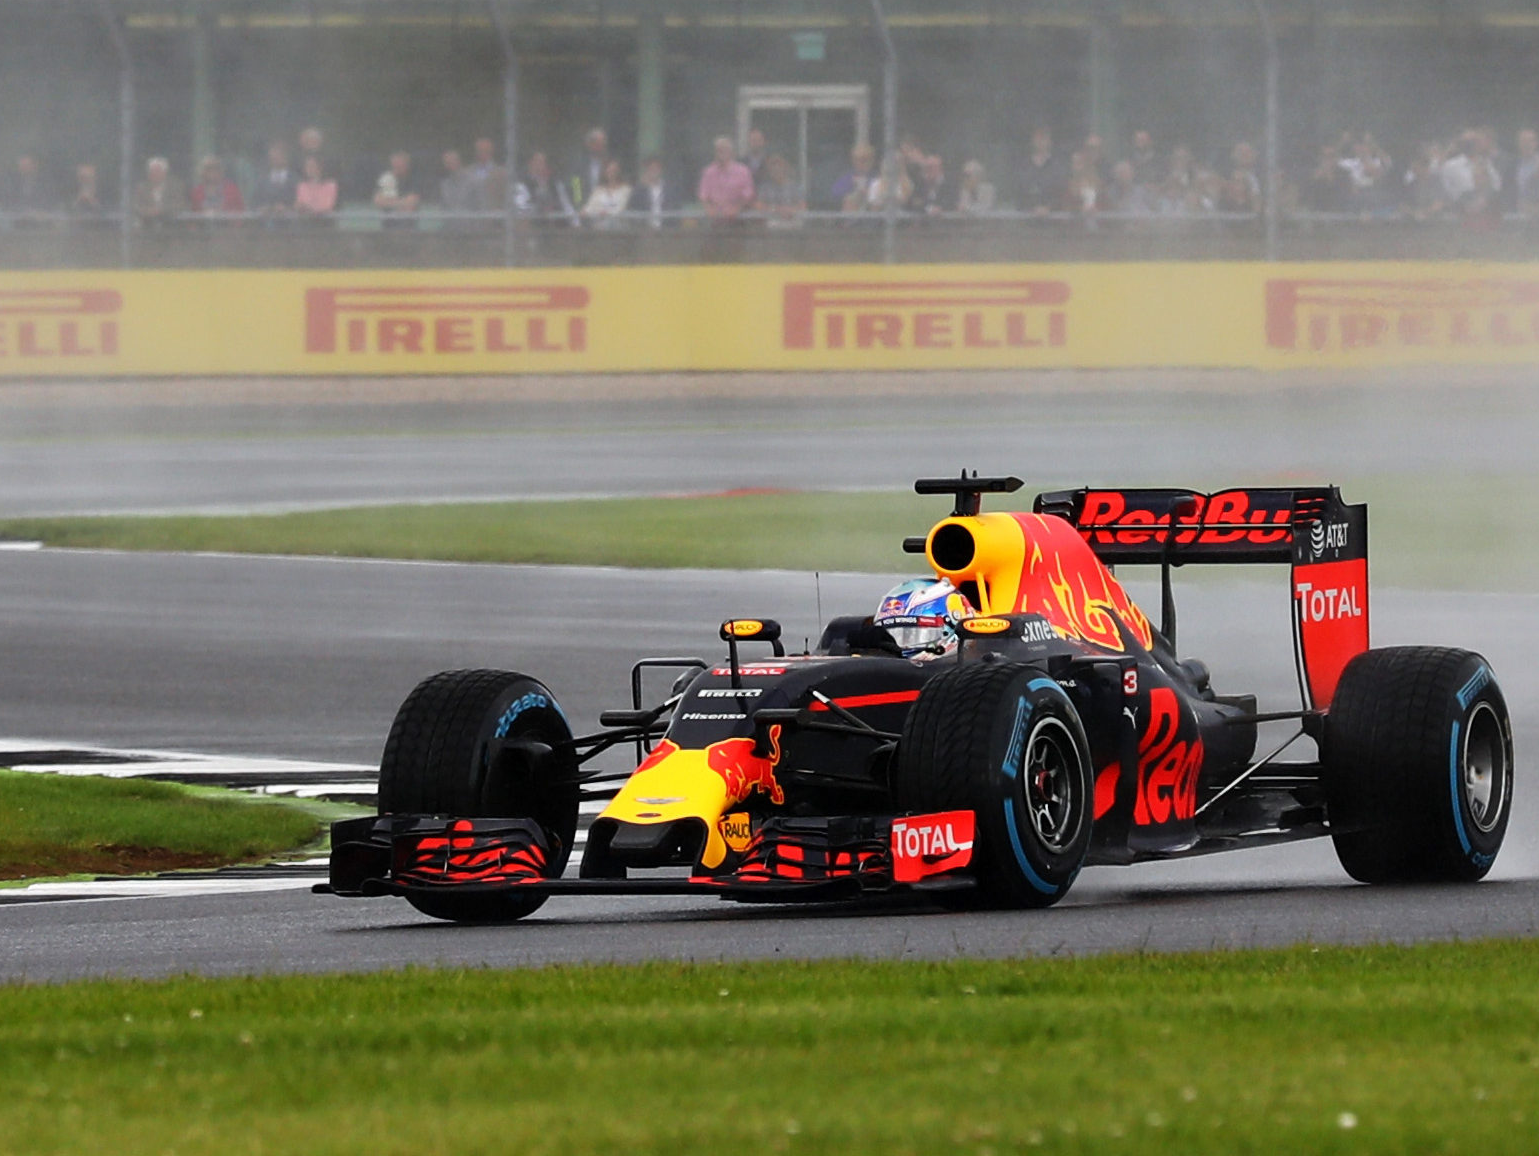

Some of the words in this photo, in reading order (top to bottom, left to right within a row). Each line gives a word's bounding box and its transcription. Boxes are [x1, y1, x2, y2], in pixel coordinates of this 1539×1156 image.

[305, 286, 590, 354] PIRELLI
[784, 281, 1071, 350] PIRELLI
[1325, 522, 1349, 549] AT&T
[1296, 582, 1361, 624] TOTAL
[697, 689, 763, 698] PIRELLI
[1123, 670, 1138, 694] 3
[681, 712, 747, 720] Hisense
[892, 823, 973, 858] TOTAL
